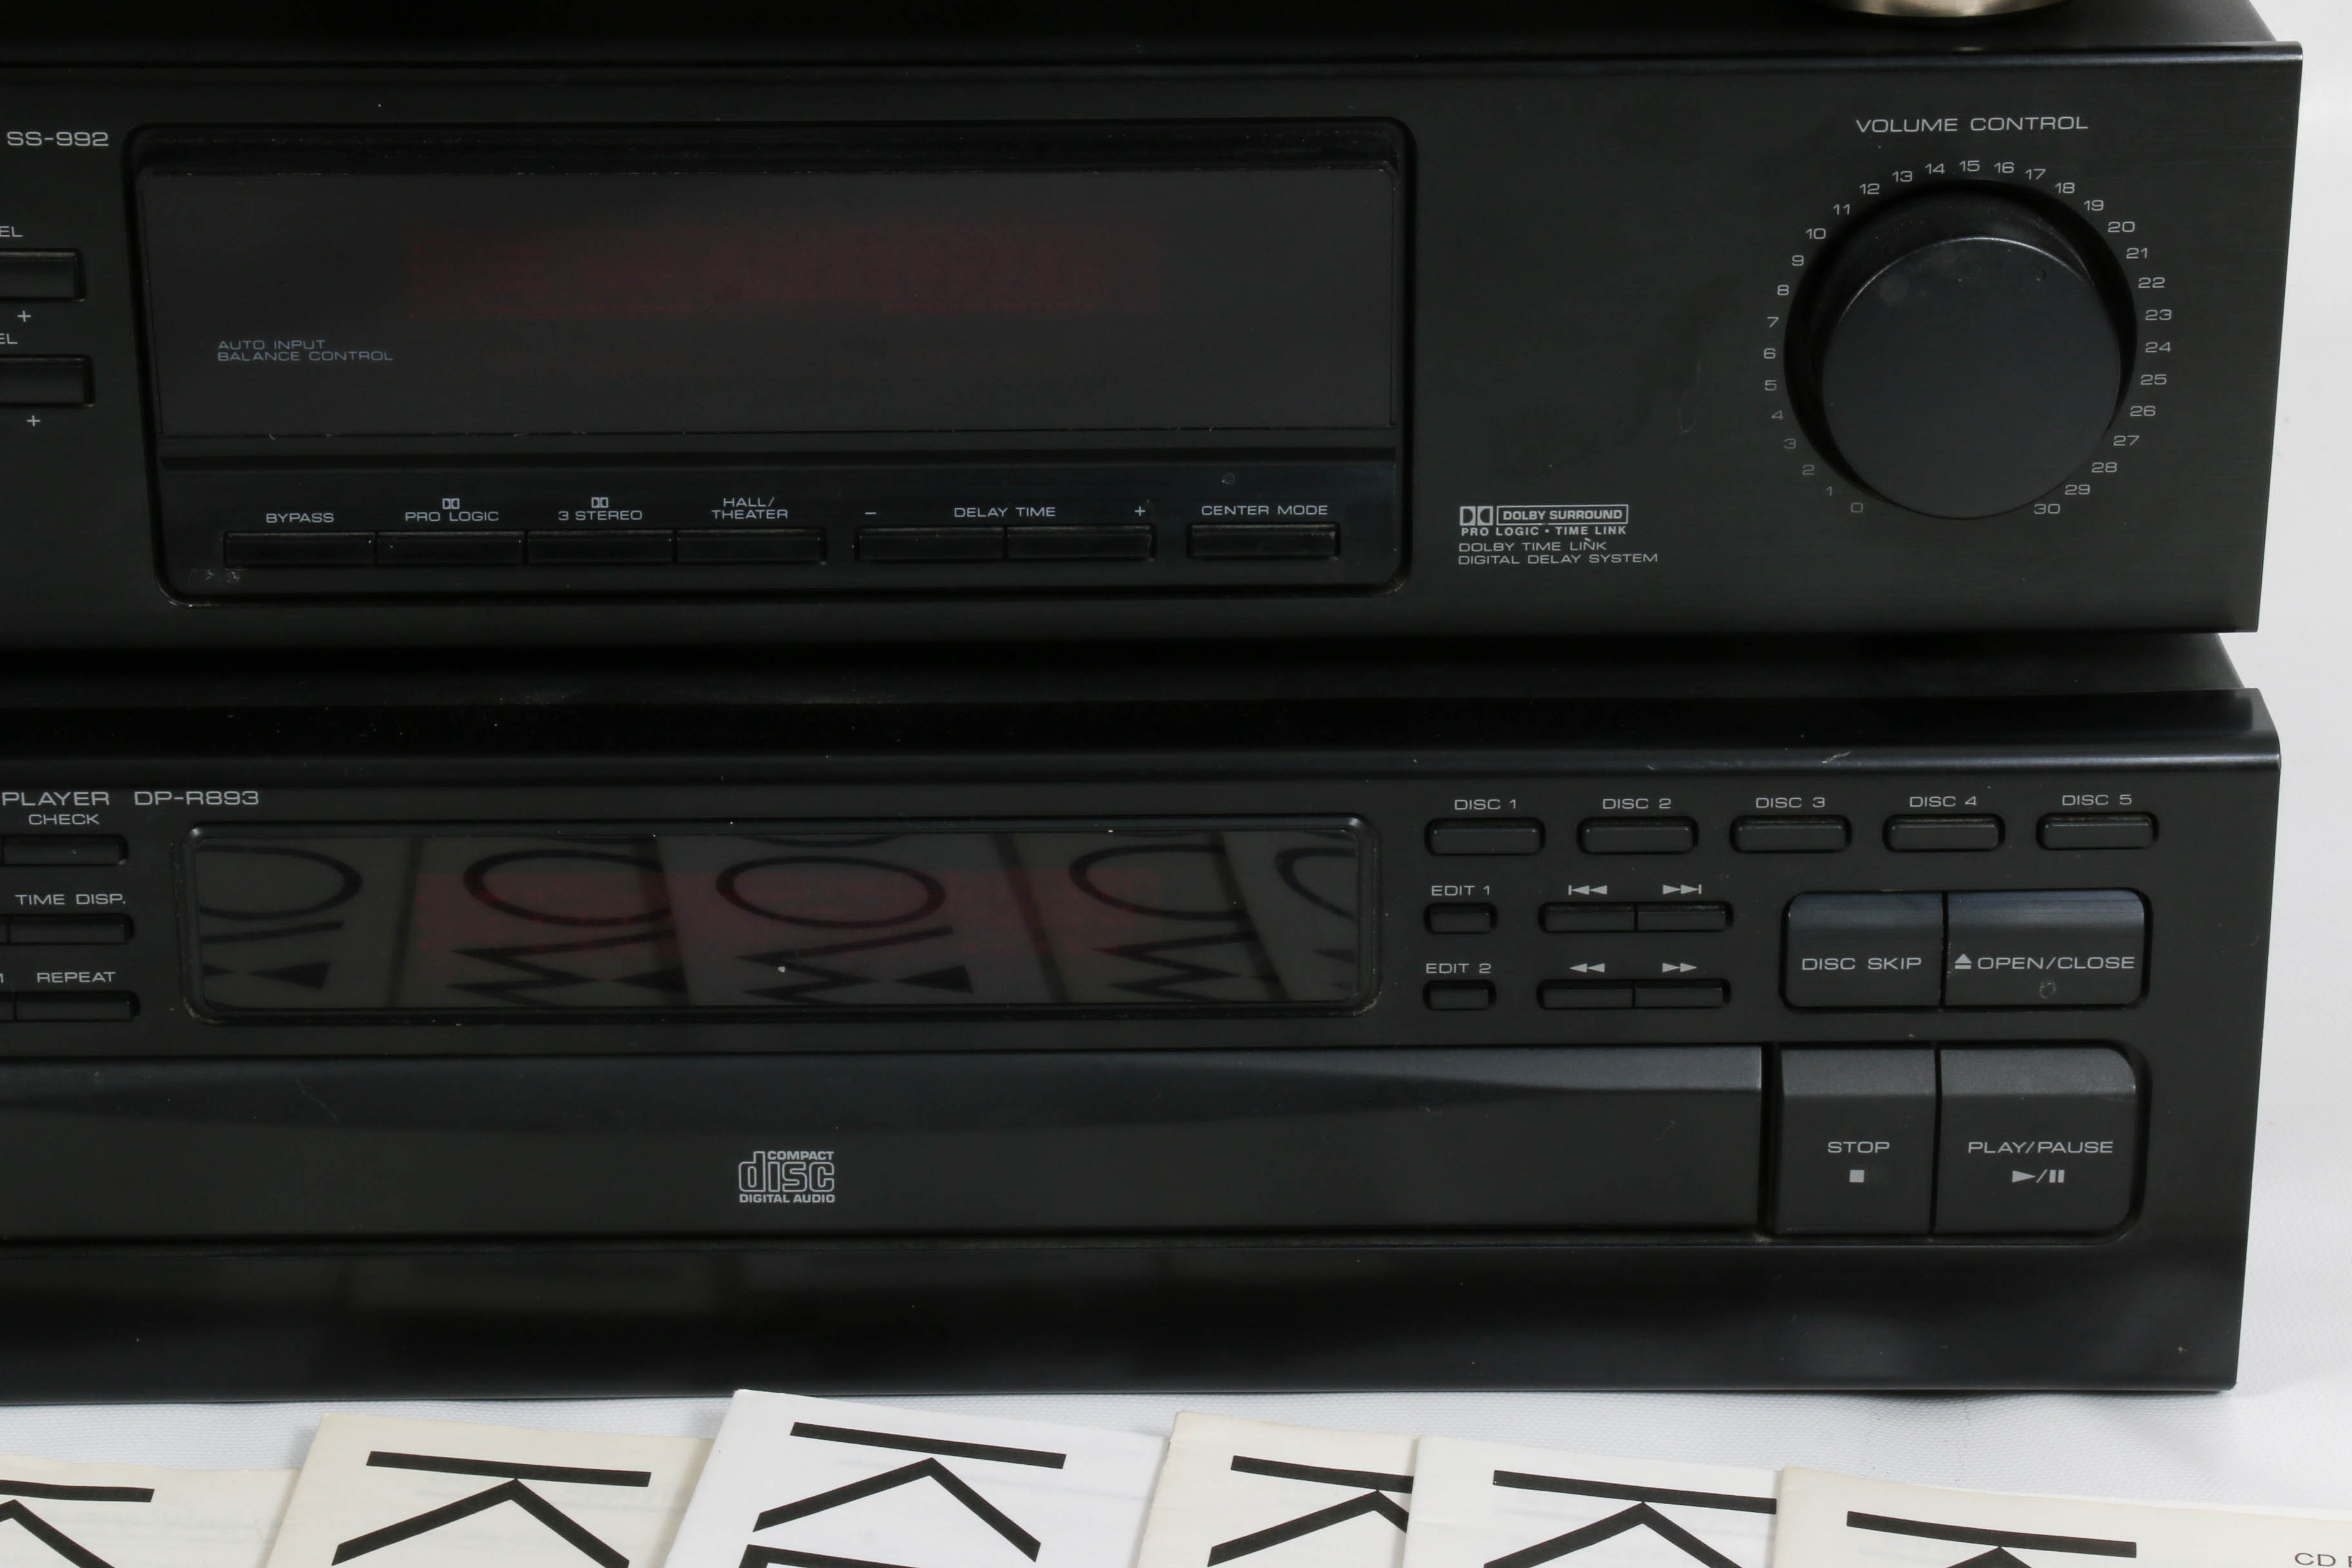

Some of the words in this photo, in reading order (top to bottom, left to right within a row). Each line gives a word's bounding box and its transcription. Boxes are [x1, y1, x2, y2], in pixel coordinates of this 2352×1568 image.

[1856, 118, 1958, 133] VOLUME
[1970, 116, 2088, 132] CONTROL
[6, 131, 109, 146] SS-992
[1925, 163, 1945, 175] 14
[1959, 160, 1980, 172] 15
[1994, 161, 2015, 173] 16
[1892, 170, 1913, 182] 13
[2025, 168, 2046, 180] 17
[1859, 182, 1880, 195] 12
[2055, 182, 2075, 194] 18
[1832, 204, 1850, 215] 11
[2083, 199, 2104, 211] 19
[2108, 220, 2135, 233] 20
[1805, 228, 1827, 240] 10
[2126, 247, 2148, 259] 21
[1791, 255, 1805, 267] 9
[2138, 277, 2166, 289] 22
[1777, 284, 1790, 296] 8
[2145, 309, 2172, 321] 23
[1767, 316, 1779, 328] 7
[217, 340, 266, 350] AUTO
[273, 340, 326, 350] INPUT
[2145, 341, 2171, 353] 24
[217, 351, 300, 362] BALANCE
[309, 351, 393, 361] CONTROL
[1763, 348, 1776, 360] 6
[1764, 379, 1777, 391] 5
[2140, 373, 2167, 386] 25
[1770, 409, 1784, 420] 4
[2130, 405, 2156, 417] 26
[1784, 438, 1797, 449] 3
[2113, 435, 2140, 446] 27
[1802, 464, 1816, 476] 2
[2091, 462, 2117, 473] 28
[1825, 486, 1833, 497] 1
[2064, 484, 2091, 495] 29
[723, 497, 774, 507] HALL/
[1850, 502, 1864, 513] 0
[711, 509, 788, 520] THEATER
[954, 507, 1008, 518] DELAY
[1015, 507, 1055, 517] TIME
[1201, 505, 1269, 516] CENTER
[1277, 505, 1328, 515] MODE
[1503, 510, 1546, 520] DOLBY
[1549, 509, 1623, 520] SURROUND
[2034, 503, 2061, 514] 30
[266, 513, 335, 524] BYPASS
[405, 511, 441, 522] PRO
[449, 511, 499, 522] LOGIC
[558, 511, 569, 521] 3
[575, 510, 643, 521] STEREO
[1460, 526, 1489, 536] PRO
[1495, 526, 1539, 536] LOGIC
[1554, 525, 1588, 535] TIME
[1594, 525, 1626, 535] LINK
[1458, 542, 1515, 553] DOLBY
[1521, 542, 1561, 551] TIME
[1570, 541, 1607, 551] LINK
[1458, 555, 1520, 565] DIGITAL
[1527, 554, 1582, 564] DELAY
[1589, 553, 1658, 564] SYSTEM
[1, 791, 110, 807] PLAYER
[134, 790, 259, 805] DP-R893
[1454, 799, 1501, 810] DISC
[1509, 799, 1516, 809] 1
[1602, 798, 1649, 810] DISC
[1658, 798, 1671, 809] 2
[1756, 797, 1802, 808] DISC
[1812, 797, 1825, 808] 3
[1909, 796, 1956, 807] DISC
[1965, 796, 1977, 806] 4
[2062, 794, 2109, 806] DISC
[2119, 794, 2132, 805] 5
[28, 814, 99, 825] CHECK
[1431, 885, 1475, 896] EDIT
[1483, 885, 1490, 896] 1
[15, 894, 65, 905] TIME
[75, 893, 126, 905] DISP.
[1426, 963, 1469, 974] EDIT
[1478, 963, 1491, 974] 2
[1801, 957, 1856, 970] DISC
[1867, 957, 1922, 970] SKIP
[1977, 956, 2135, 970] OPEN/CLOSE
[36, 971, 116, 983] REPEAT
[1827, 1141, 1890, 1153] STOP
[1968, 1141, 2113, 1154] PLAY/PAUSE
[767, 1150, 834, 1161] COMPACT
[738, 1150, 835, 1193] disc
[739, 1193, 790, 1203] DIGITAL
[793, 1193, 836, 1203] AUDIO
[2294, 1553, 2337, 1567] CD
